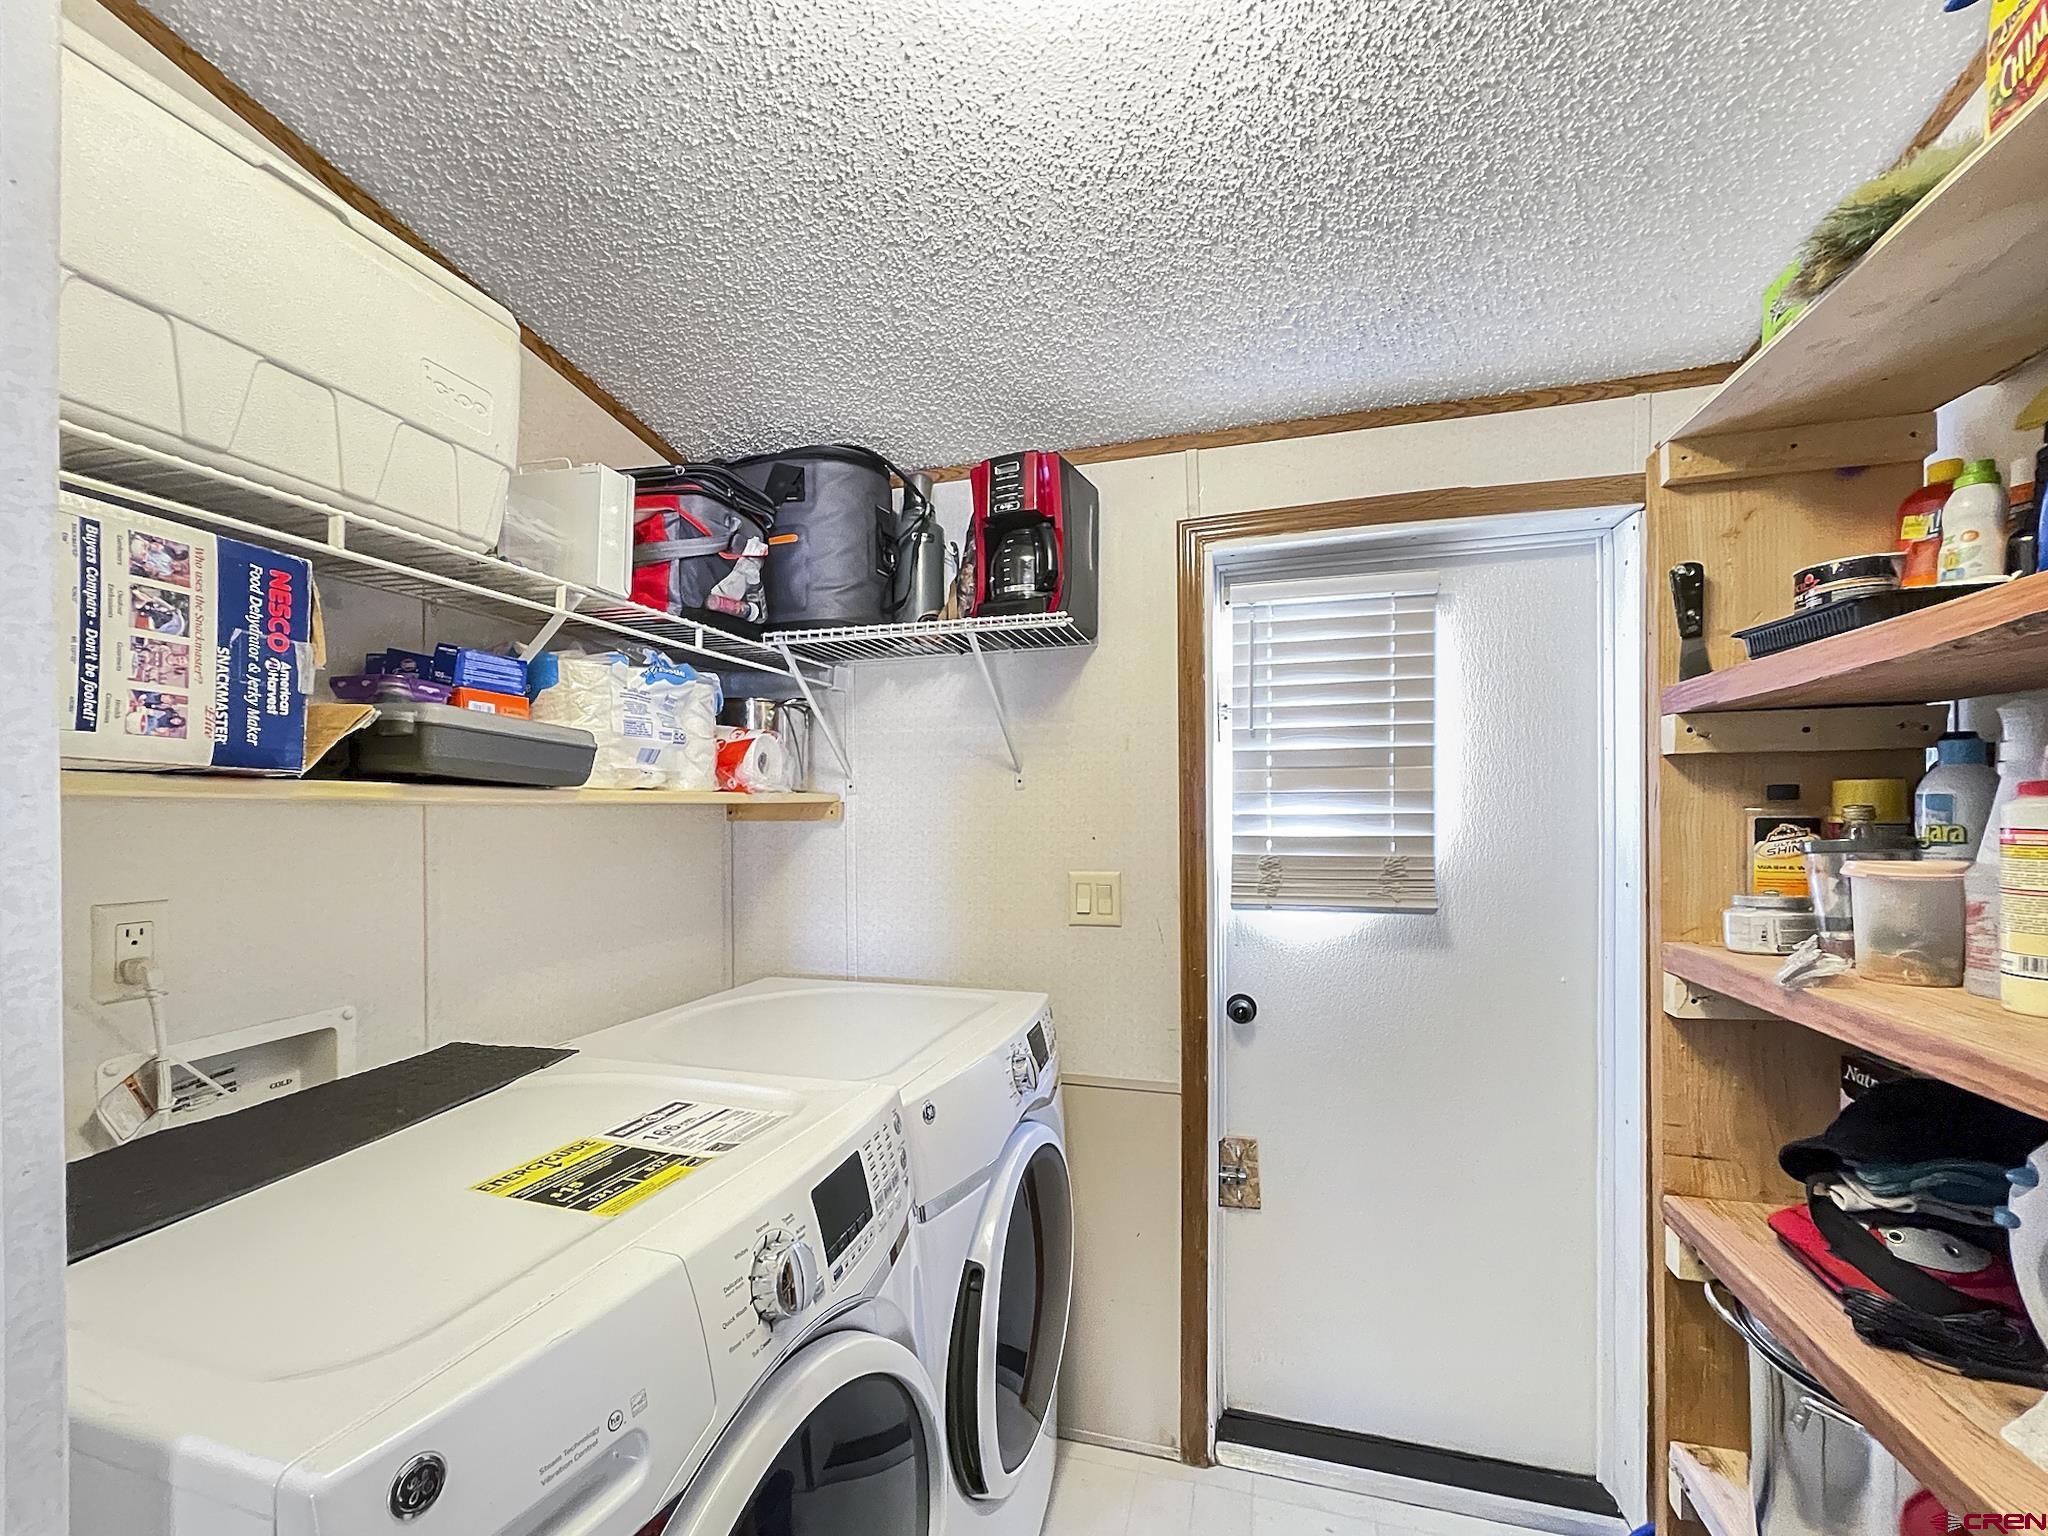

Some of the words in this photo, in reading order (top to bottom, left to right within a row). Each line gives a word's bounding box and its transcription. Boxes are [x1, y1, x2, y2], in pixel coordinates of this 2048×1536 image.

[2000, 2, 2048, 98] CHIM
[83, 523, 99, 563] Buyers
[194, 547, 205, 569] Who
[83, 566, 99, 618] Compare
[194, 571, 204, 593] uses
[248, 563, 264, 594] Food
[194, 594, 205, 612] the
[267, 568, 292, 653] NESCO
[84, 627, 98, 661] Don't
[245, 595, 264, 660] Dehydrator
[84, 663, 98, 678] be
[248, 663, 261, 674] &
[214, 646, 231, 743] SNACKMASTER
[244, 675, 262, 705] Jerky
[267, 672, 280, 716] Harvest
[279, 661, 293, 716] American
[203, 705, 215, 739] Elite
[246, 707, 261, 747] Maker
[1766, 845, 1802, 856] SHIN
[269, 1078, 293, 1089] COLD
[643, 1124, 680, 1141] 166
[538, 1455, 562, 1476] Steam
[563, 1426, 600, 1457] Technology
[540, 1461, 573, 1486] Vibration
[573, 1439, 599, 1461] Control
